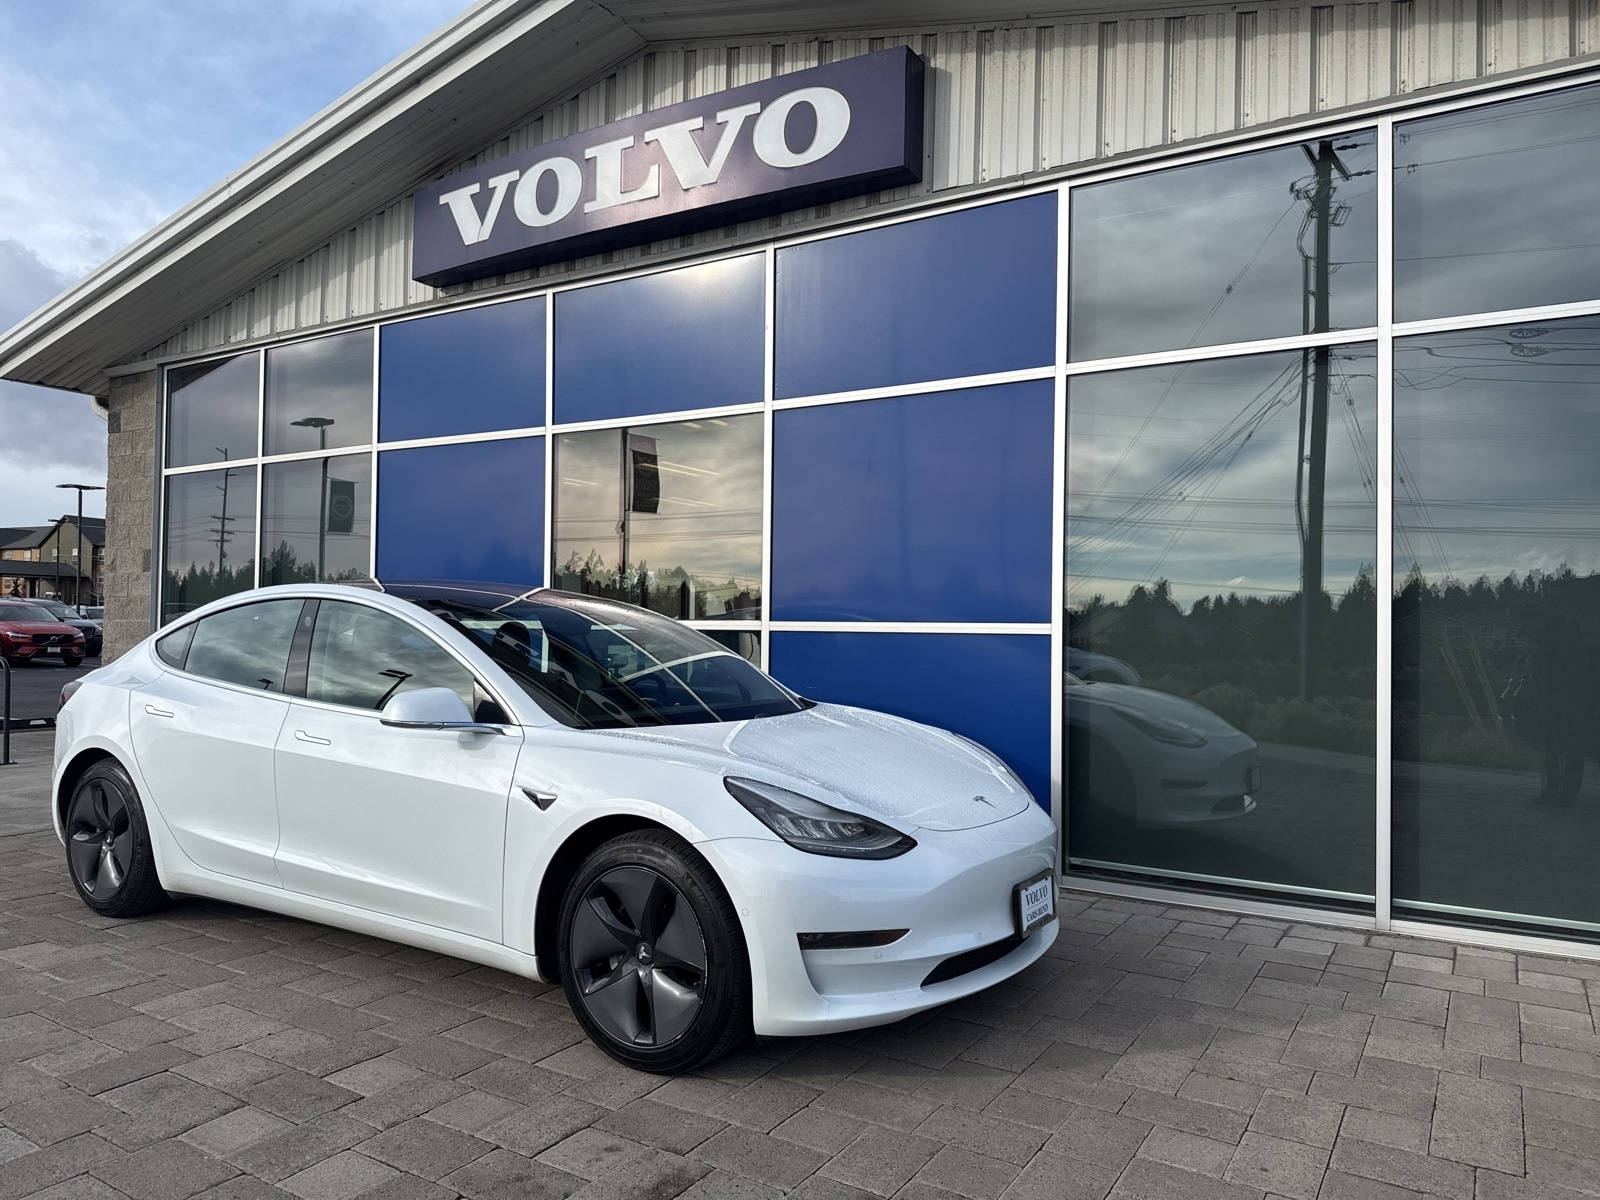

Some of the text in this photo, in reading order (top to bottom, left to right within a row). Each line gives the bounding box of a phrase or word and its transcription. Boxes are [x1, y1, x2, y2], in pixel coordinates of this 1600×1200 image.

[438, 86, 851, 246] VOLVO
[1025, 884, 1048, 906] VOLVO
[1026, 909, 1038, 923] CARS
